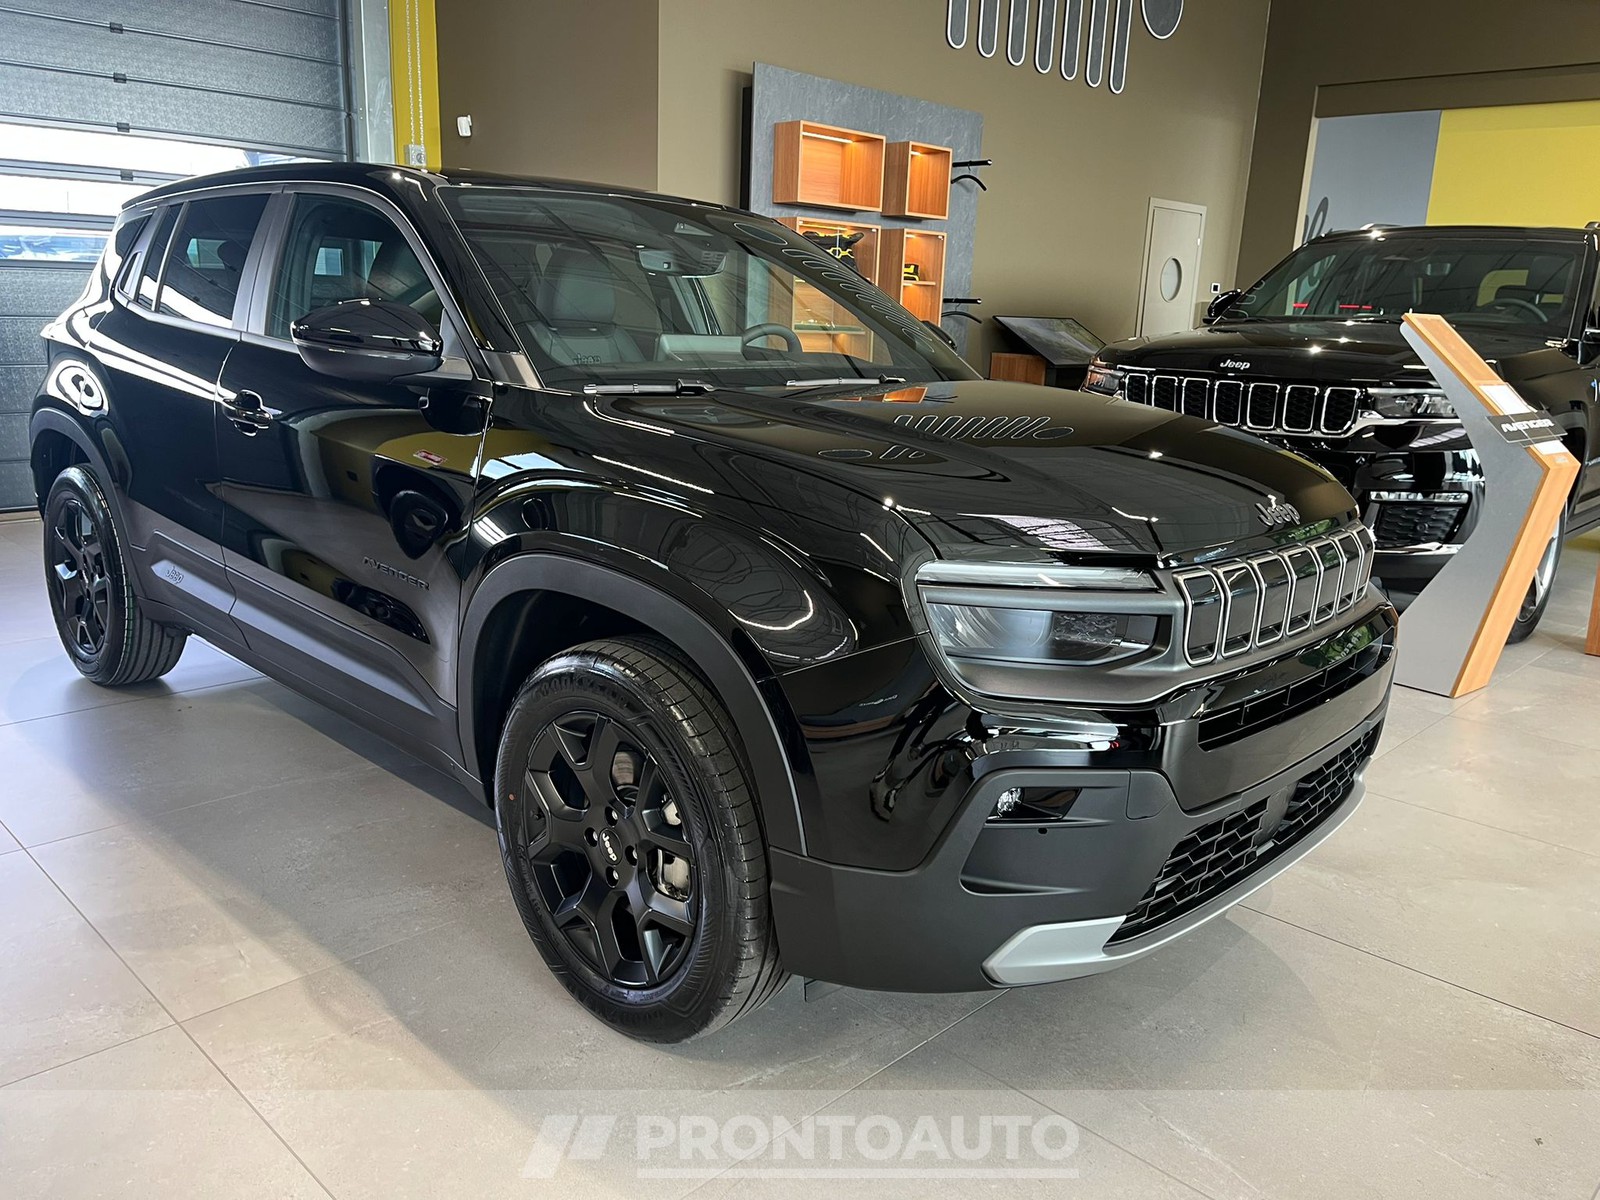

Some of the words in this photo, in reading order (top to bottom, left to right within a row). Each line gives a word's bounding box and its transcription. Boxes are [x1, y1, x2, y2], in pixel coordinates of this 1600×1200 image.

[1220, 359, 1251, 370] Jeep
[1501, 418, 1555, 433] AVENGER
[1255, 502, 1301, 526] Jeep
[166, 565, 185, 584] Jeep
[362, 556, 430, 591] AVENGER
[602, 833, 617, 861] Jeep
